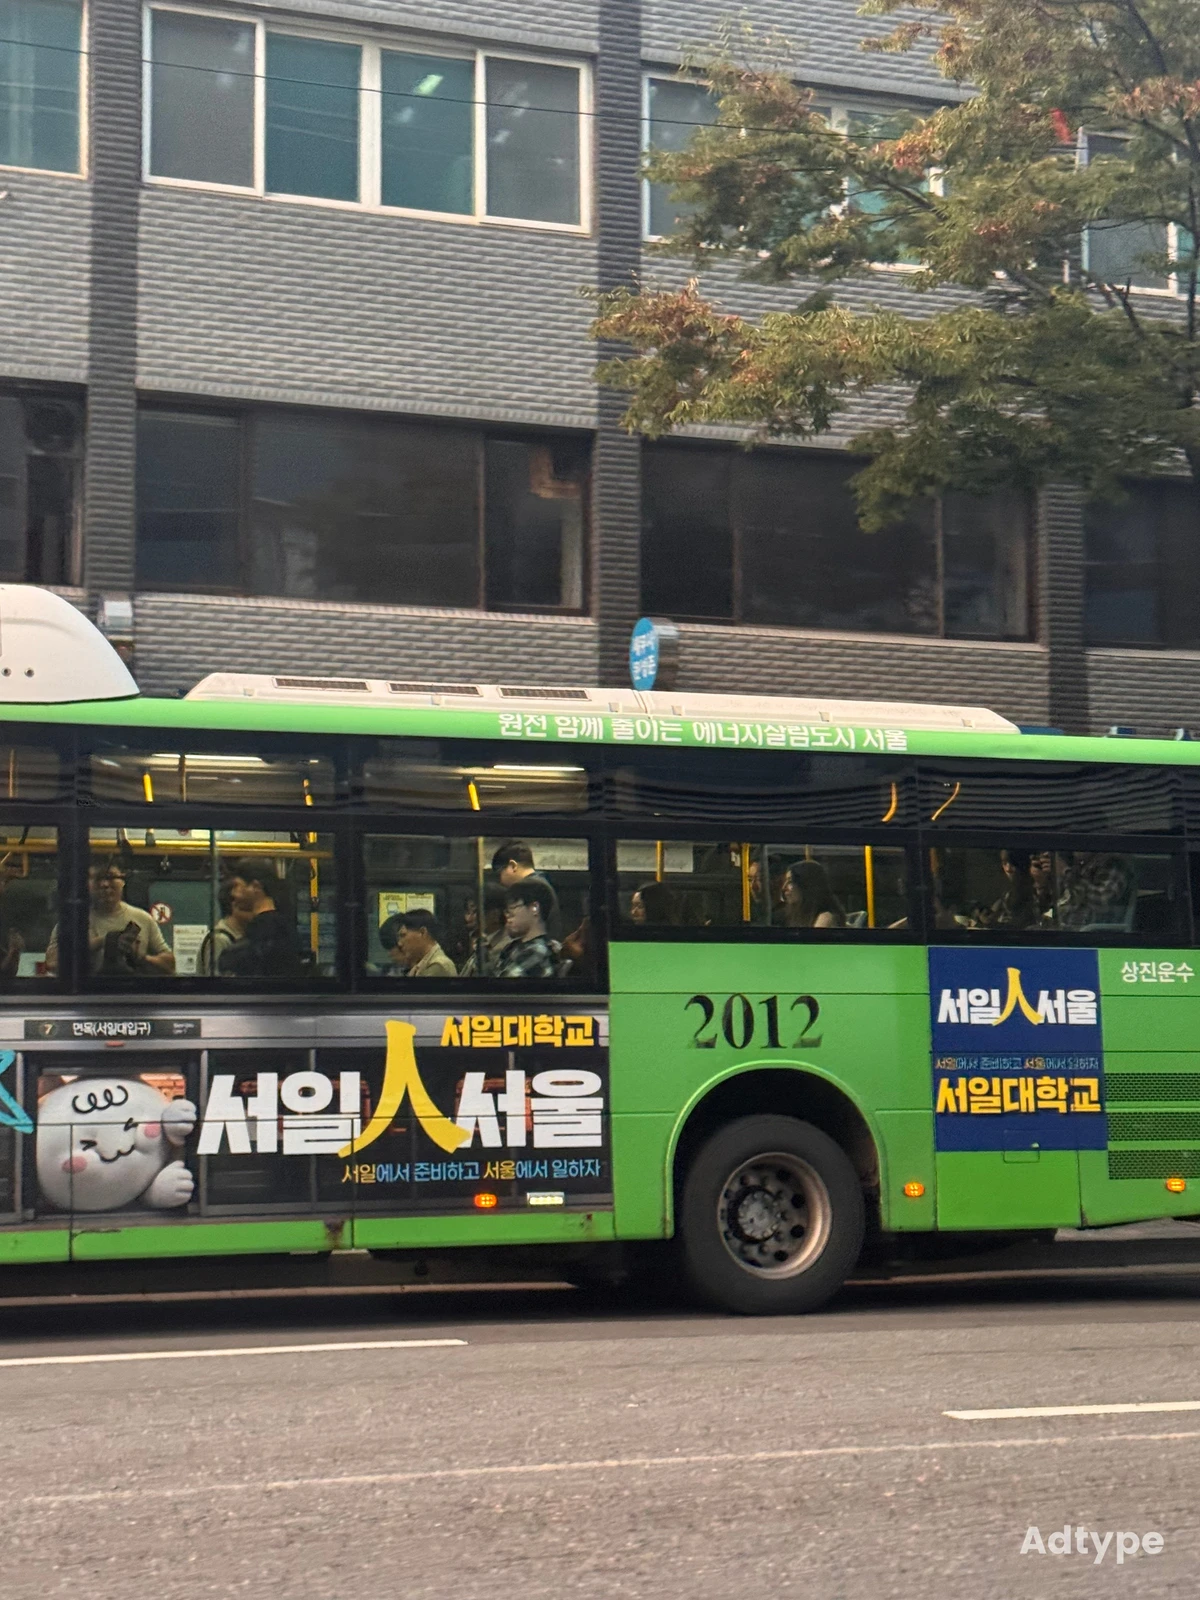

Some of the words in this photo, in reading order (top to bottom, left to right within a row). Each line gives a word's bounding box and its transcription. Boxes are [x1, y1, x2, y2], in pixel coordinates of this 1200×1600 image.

[498, 713, 547, 738] 원전
[554, 715, 604, 740] 함께
[611, 717, 683, 742] 줄이는
[692, 721, 856, 749] 에너지살림도시
[863, 728, 908, 751] 서울
[1121, 961, 1195, 983] 상진운수
[43, 1024, 53, 1035] 7
[440, 1014, 595, 1048] 서일대학교
[684, 992, 823, 1049] 2012
[936, 1076, 1102, 1114] 서일대학교
[342, 1163, 410, 1184] 서일에서
[414, 1161, 480, 1183] 준비하고
[483, 1159, 548, 1181] 서울에서
[552, 1158, 601, 1179] 일하자
